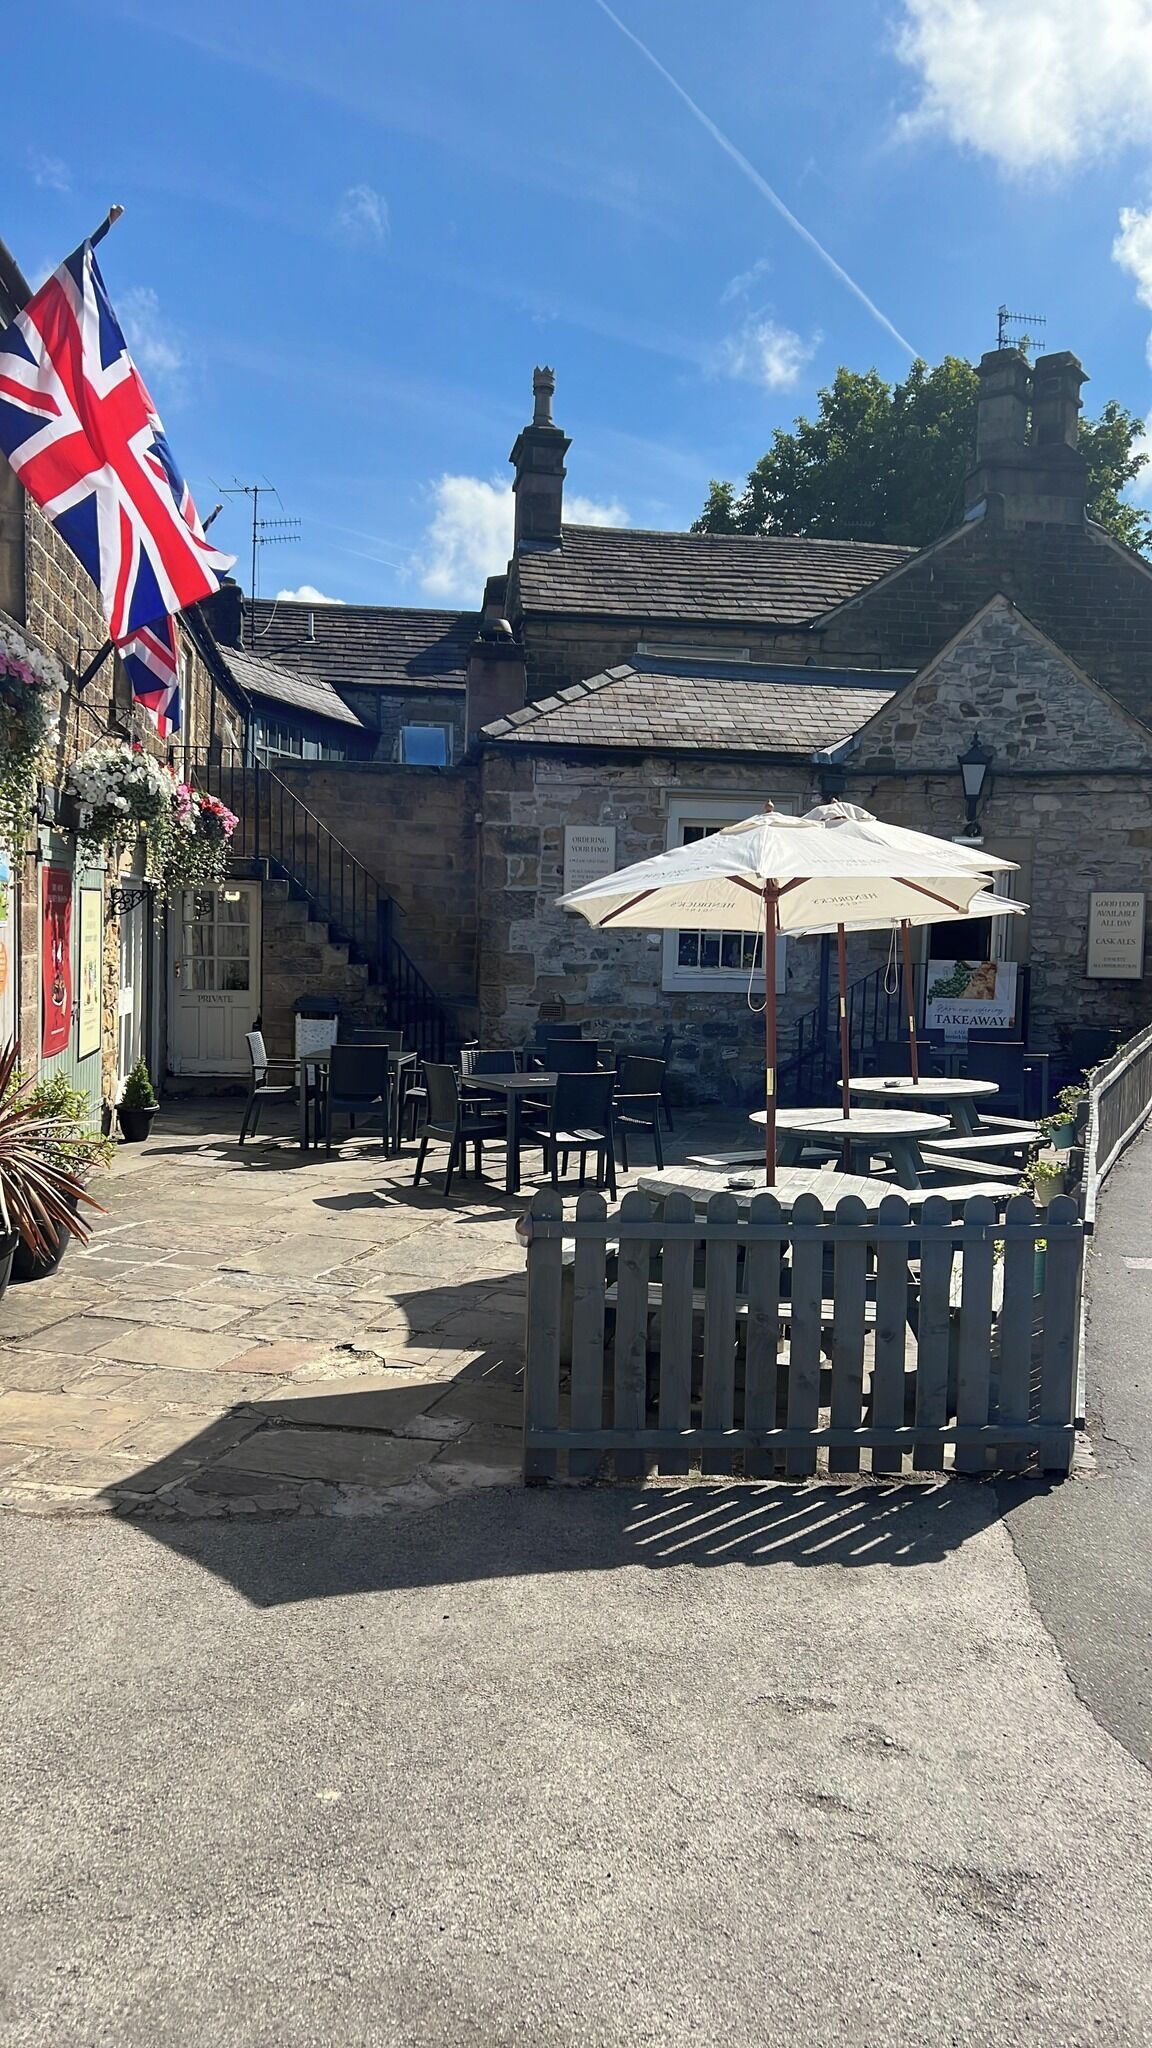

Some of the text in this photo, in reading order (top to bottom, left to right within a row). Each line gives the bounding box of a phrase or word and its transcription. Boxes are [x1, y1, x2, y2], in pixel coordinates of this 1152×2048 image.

[572, 836, 607, 844] ORDERING
[1096, 910, 1137, 918] AVAILABLE
[1116, 938, 1137, 946] ALES
[198, 994, 233, 1003] PRIVATE
[934, 1014, 1007, 1026] TAKEAWAY
